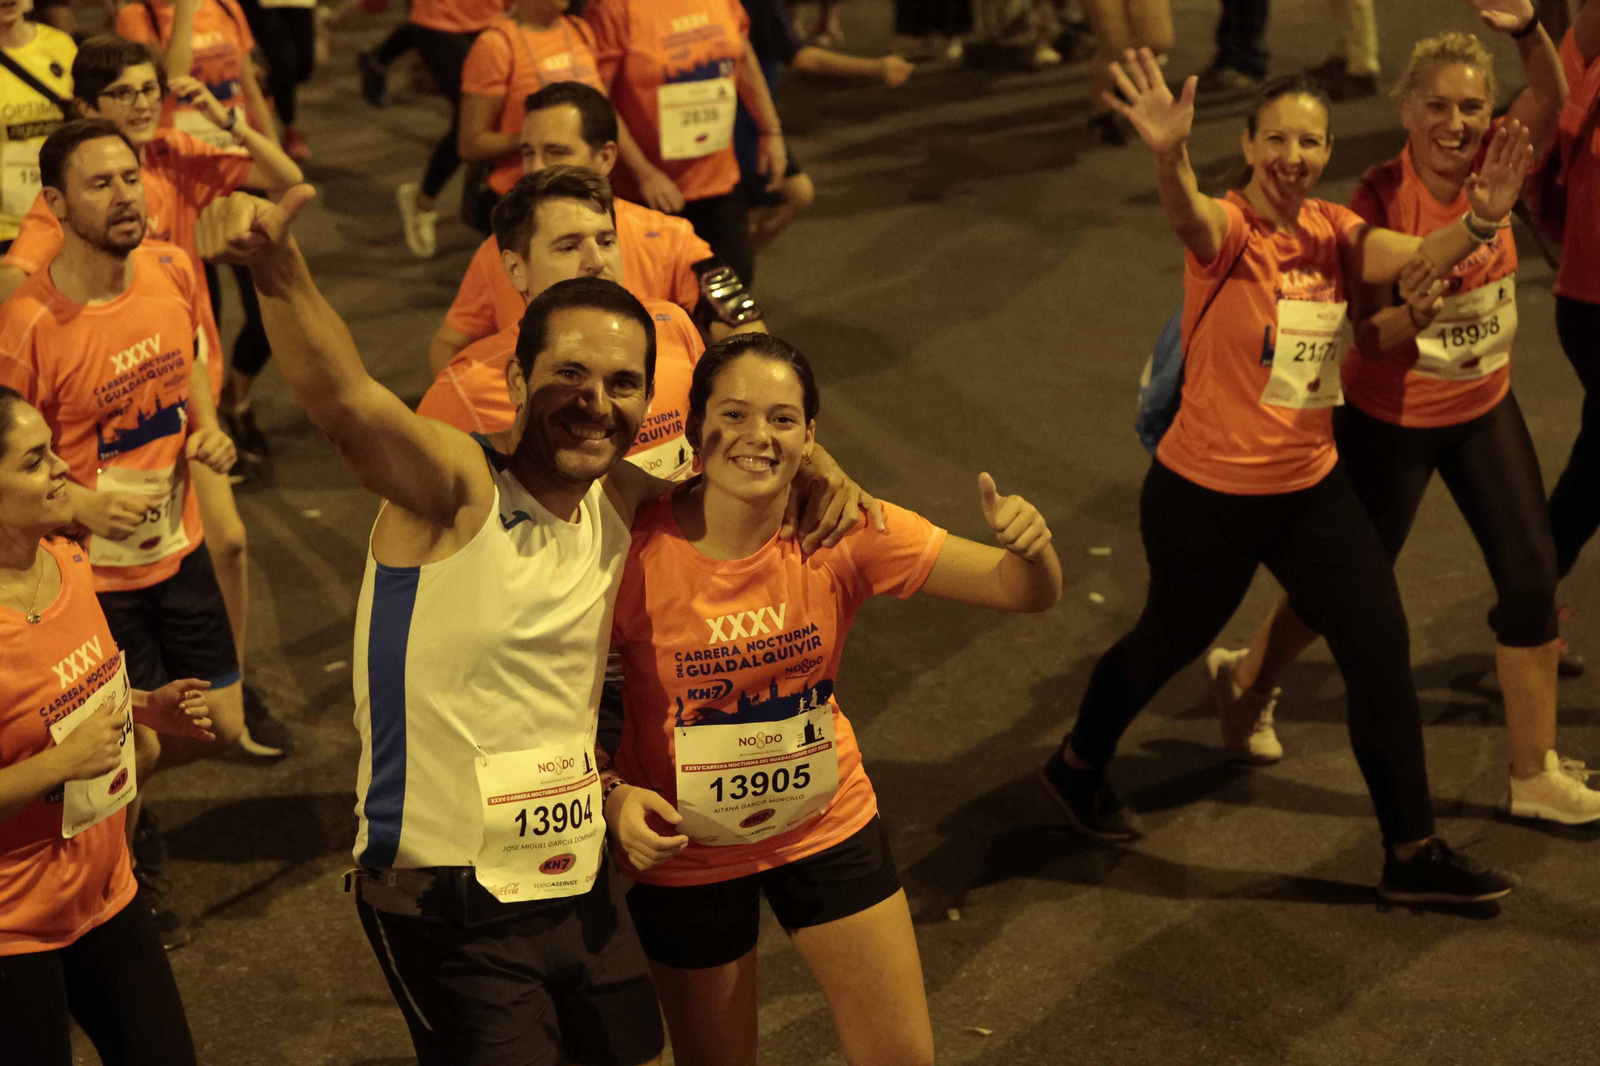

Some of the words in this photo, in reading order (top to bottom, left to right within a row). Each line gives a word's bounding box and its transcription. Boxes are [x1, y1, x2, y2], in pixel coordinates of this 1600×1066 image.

[110, 333, 160, 375] XXXV
[675, 645, 742, 663] CARRERA
[746, 622, 819, 653] NOCTURNA
[706, 603, 787, 645] XXXV
[51, 634, 104, 690] XXXV
[687, 636, 822, 677] GUADALQUIVIR
[39, 683, 85, 717] CARRERA
[702, 763, 728, 771] CARRERA
[728, 760, 759, 769] NOCTURNA
[709, 763, 811, 803] 13905
[507, 794, 531, 802] CARRERA
[515, 794, 593, 837] 13904
[713, 806, 739, 814] AITANA
[740, 800, 768, 809] GARCIA
[769, 794, 805, 804] MORCILLO
[502, 844, 519, 852] JOSE
[521, 841, 547, 850] MIGUEL
[548, 838, 574, 848] GARCIA
